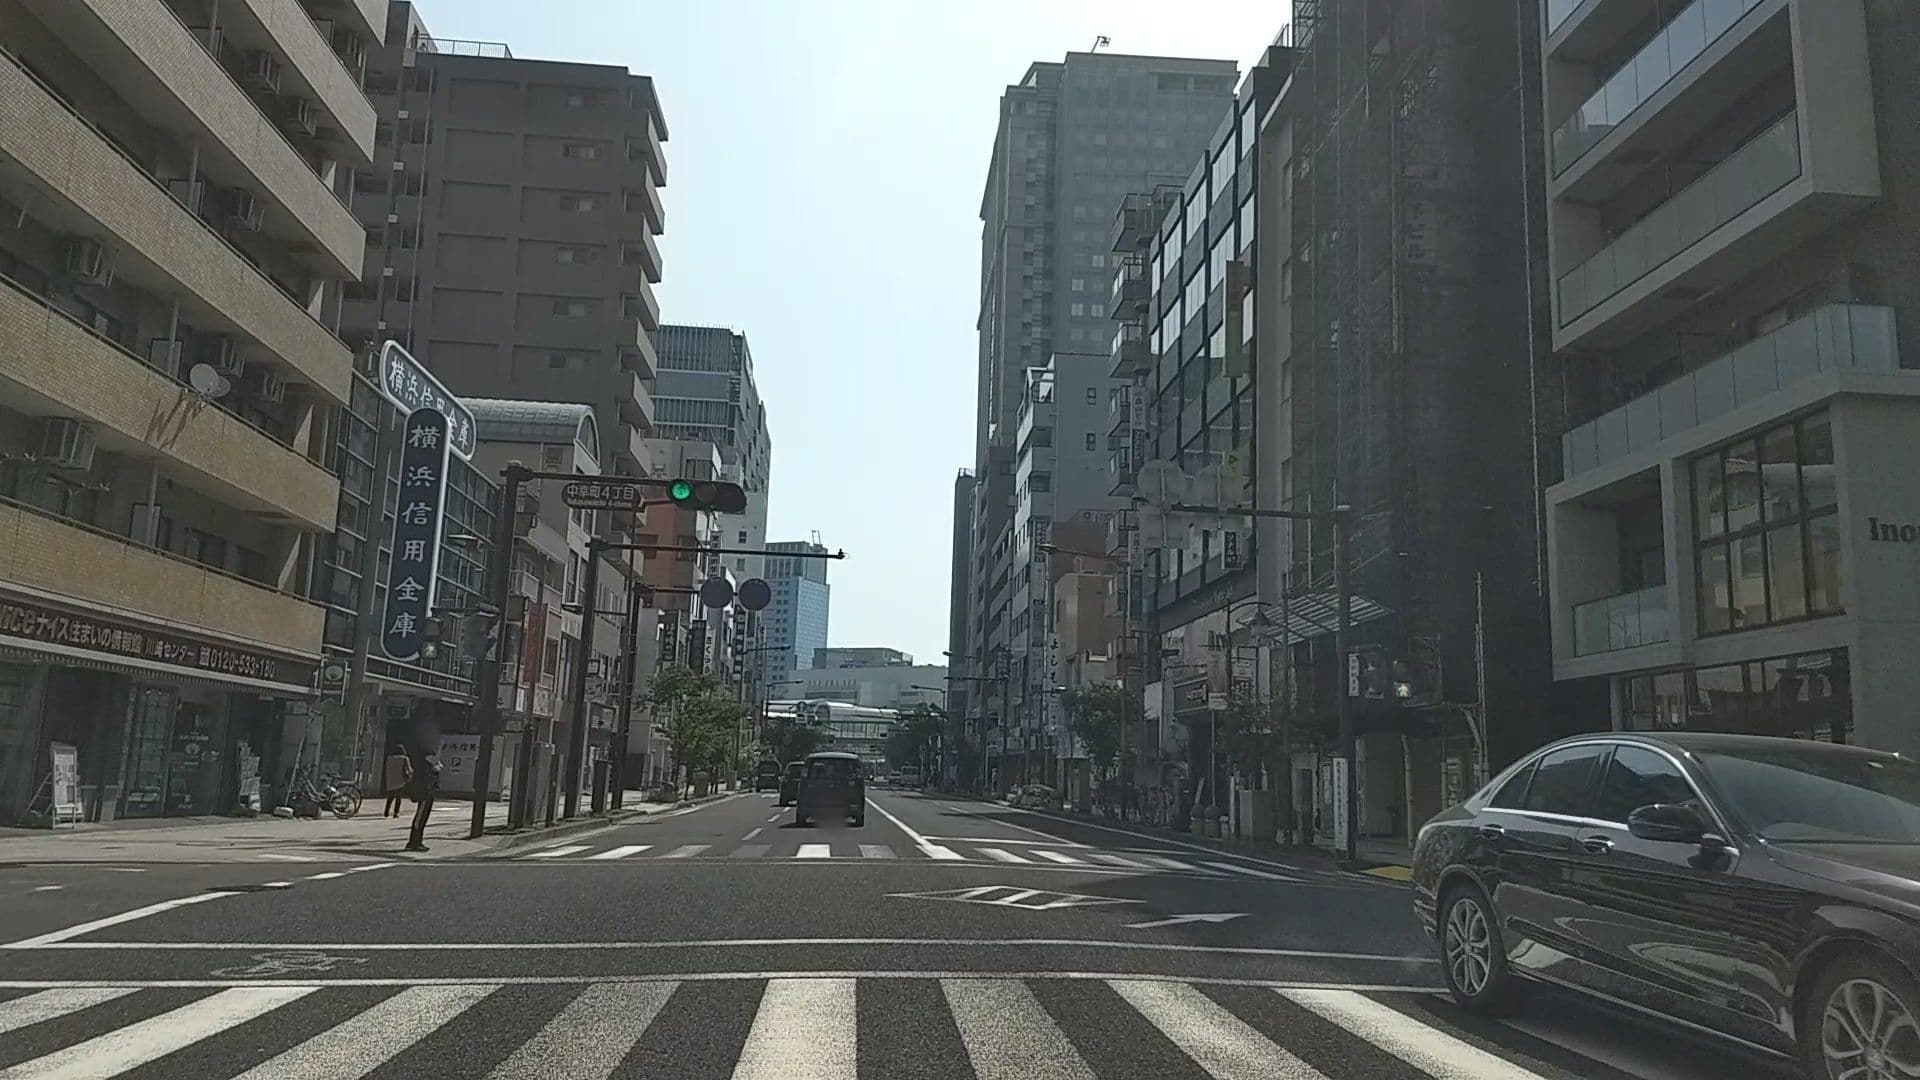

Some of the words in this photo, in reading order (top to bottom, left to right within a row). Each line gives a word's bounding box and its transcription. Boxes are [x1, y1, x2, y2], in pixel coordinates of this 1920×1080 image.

[567, 485, 634, 500] 中幸町4丁目
[389, 424, 441, 639] 横浜信用金庫
[1868, 517, 1920, 543] Ino
[144, 637, 196, 661] 川崎センター
[210, 650, 276, 679] 0120-533-180
